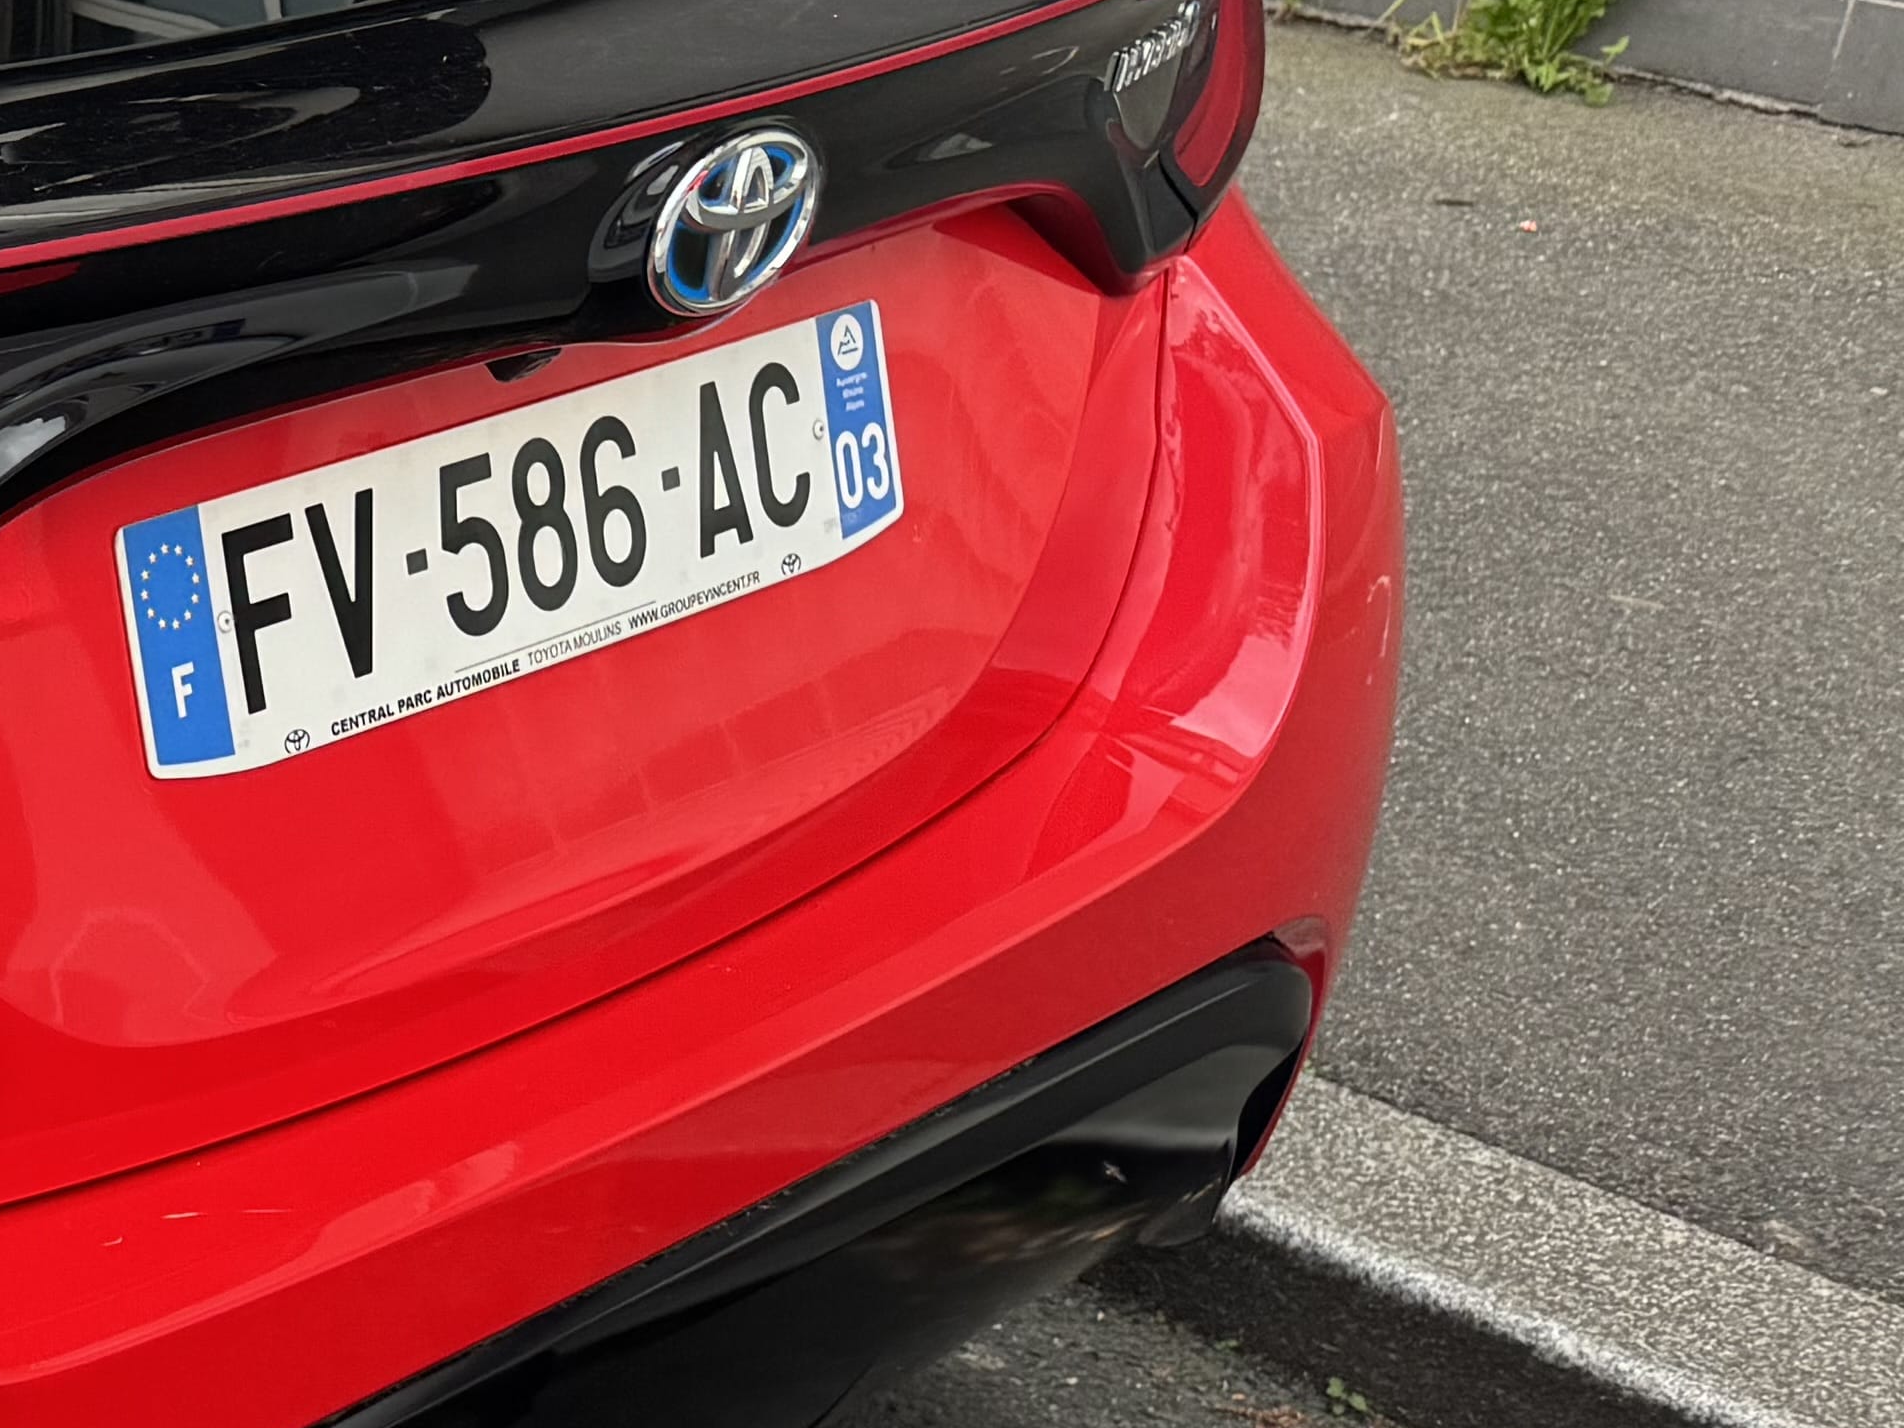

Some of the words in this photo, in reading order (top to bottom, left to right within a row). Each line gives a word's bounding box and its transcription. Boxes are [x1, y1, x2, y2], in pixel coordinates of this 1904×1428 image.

[835, 421, 890, 510] 03
[221, 362, 811, 715] FV-586-AC
[171, 661, 195, 719] F
[330, 703, 395, 736] CENTRAL
[397, 689, 433, 714] PARC
[436, 658, 521, 700] AUTOMOBILE
[527, 639, 573, 667] TOYOTA
[574, 620, 623, 651] MOULINS
